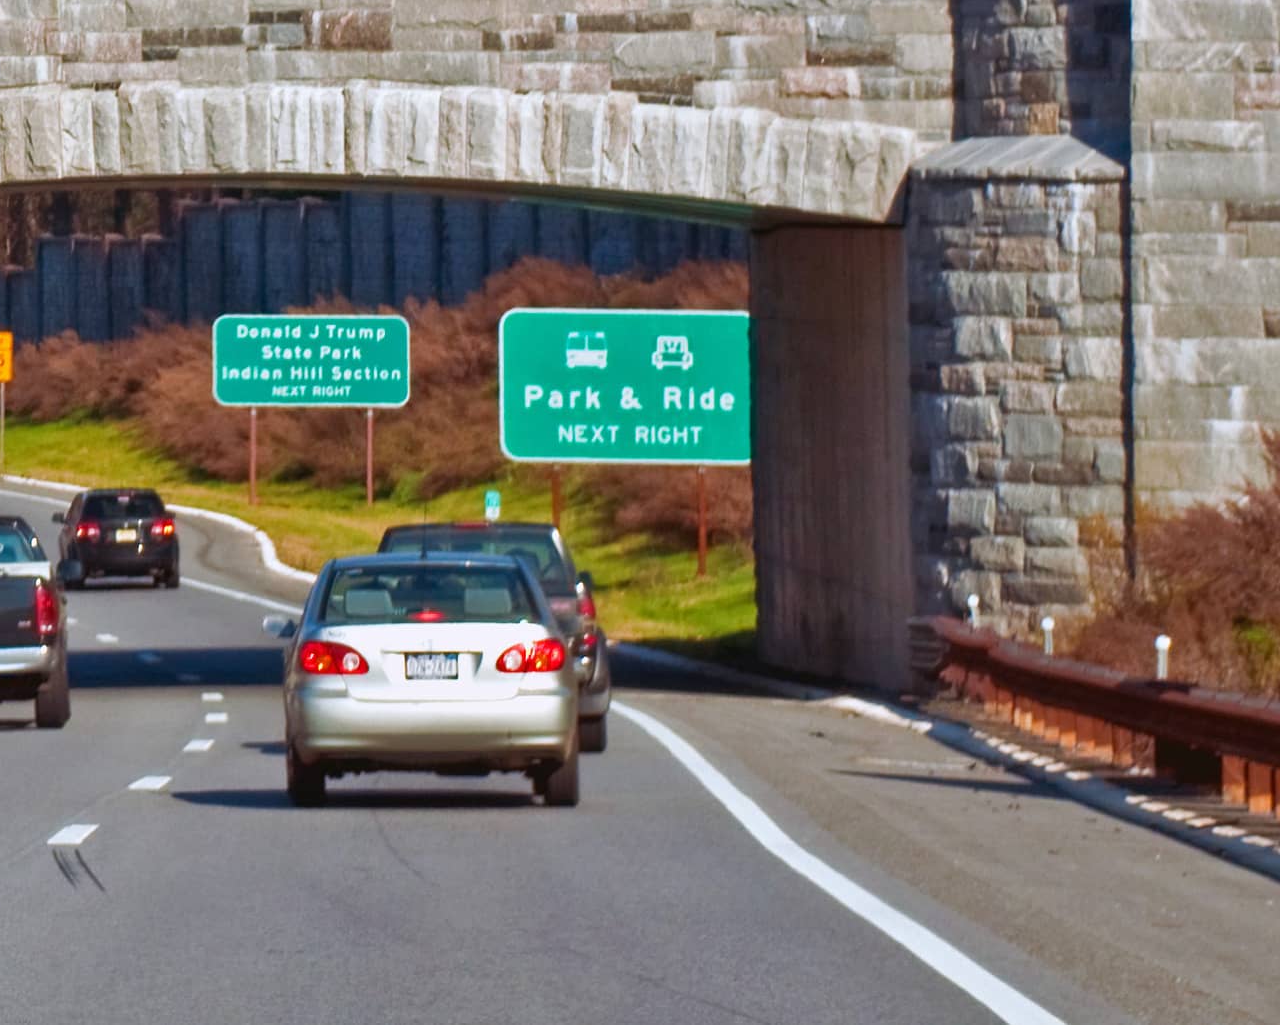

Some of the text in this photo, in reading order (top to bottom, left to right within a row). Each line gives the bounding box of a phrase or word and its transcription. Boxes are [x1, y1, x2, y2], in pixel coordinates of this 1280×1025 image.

[236, 324, 386, 342] Donald J Trump
[261, 345, 361, 360] State Park
[221, 365, 401, 381] Indian Hill Section
[271, 386, 352, 397] NEXT RIGHT
[524, 384, 735, 411] Park & Ride
[558, 424, 703, 444] NEXT RIGHT
